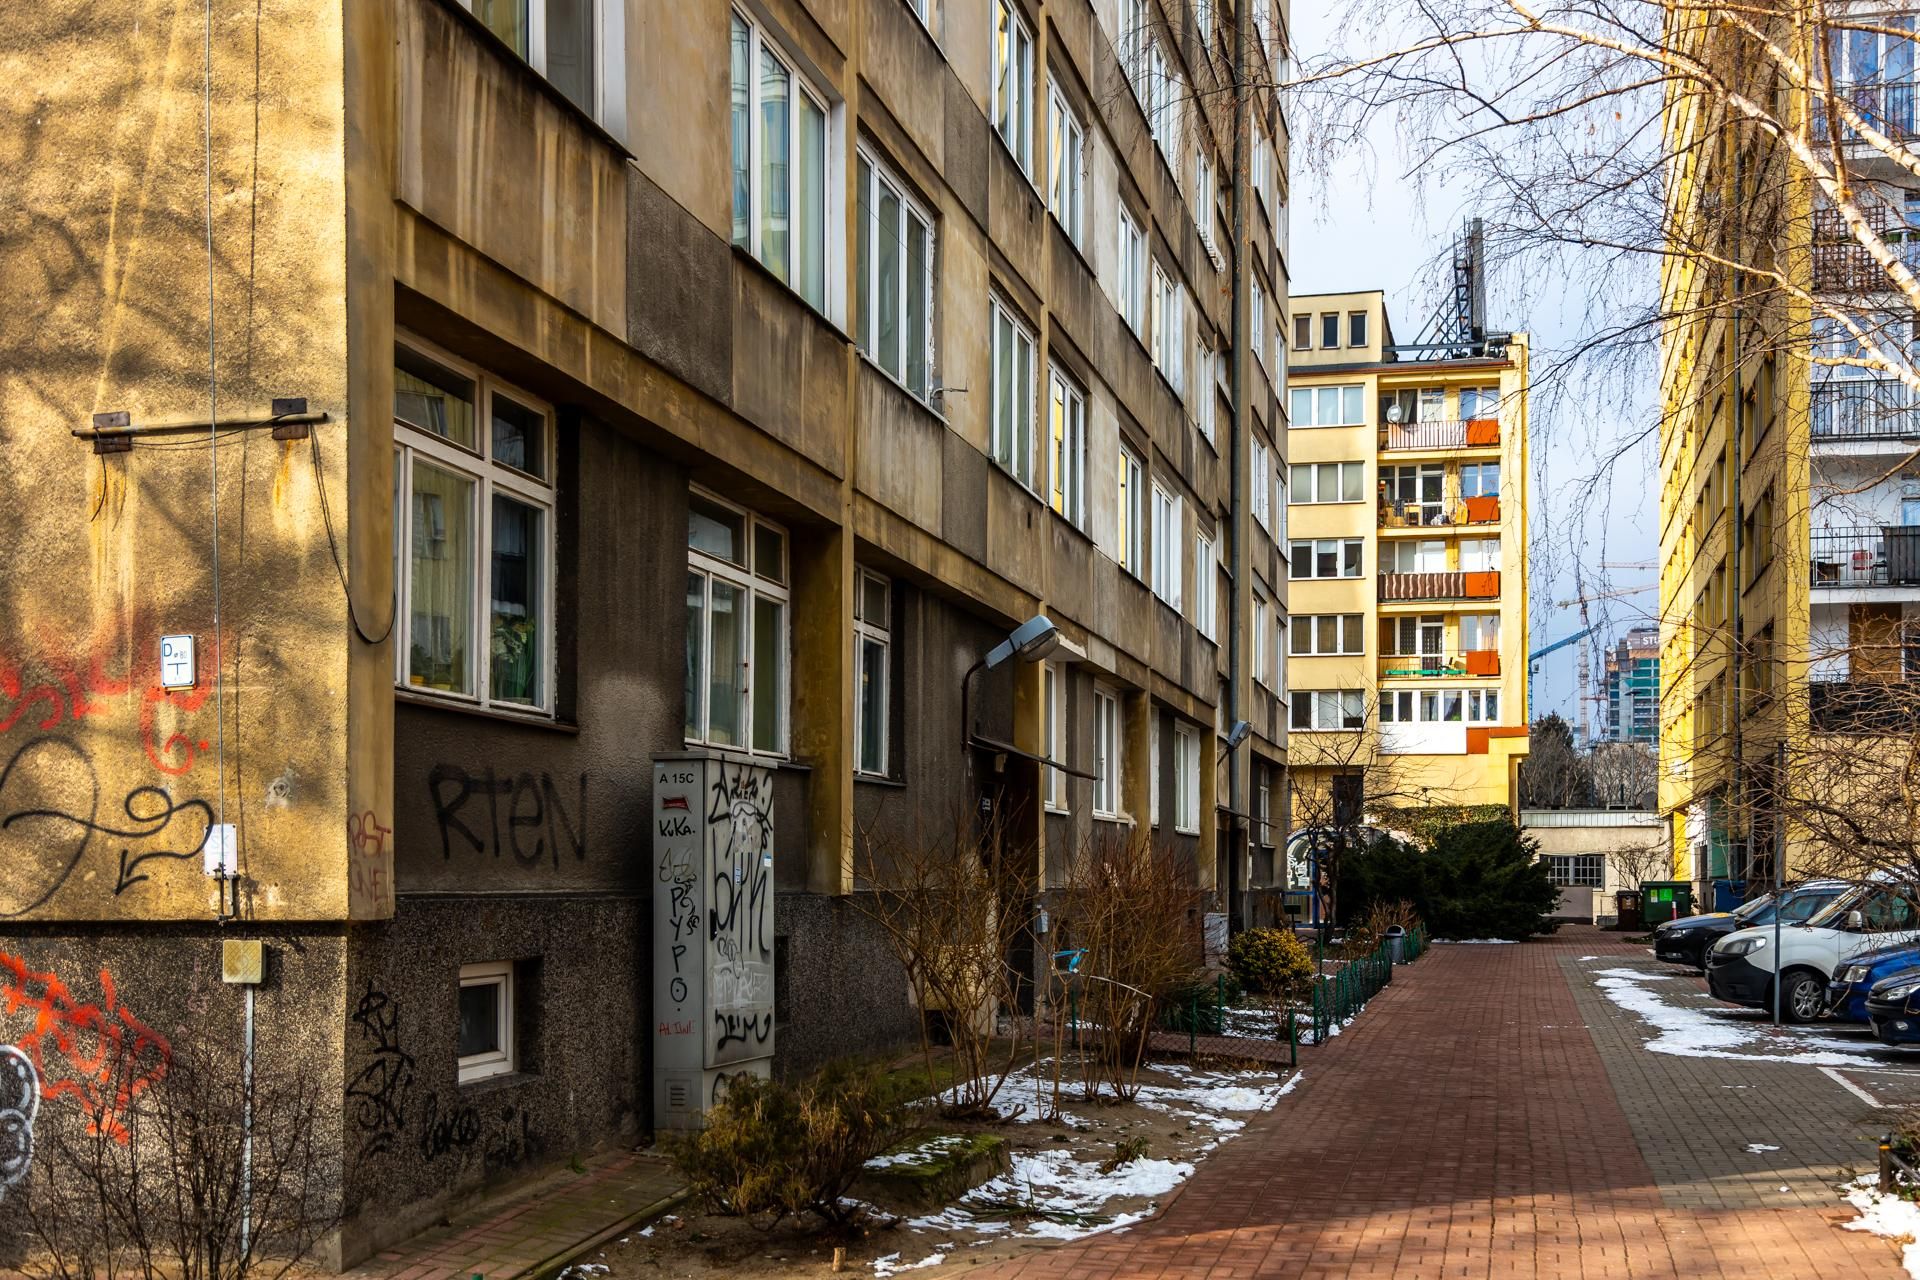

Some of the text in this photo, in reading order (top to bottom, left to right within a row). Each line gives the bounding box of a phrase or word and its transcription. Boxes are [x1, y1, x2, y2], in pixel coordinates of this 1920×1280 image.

[163, 643, 173, 657] D
[659, 773, 694, 784] A 15C
